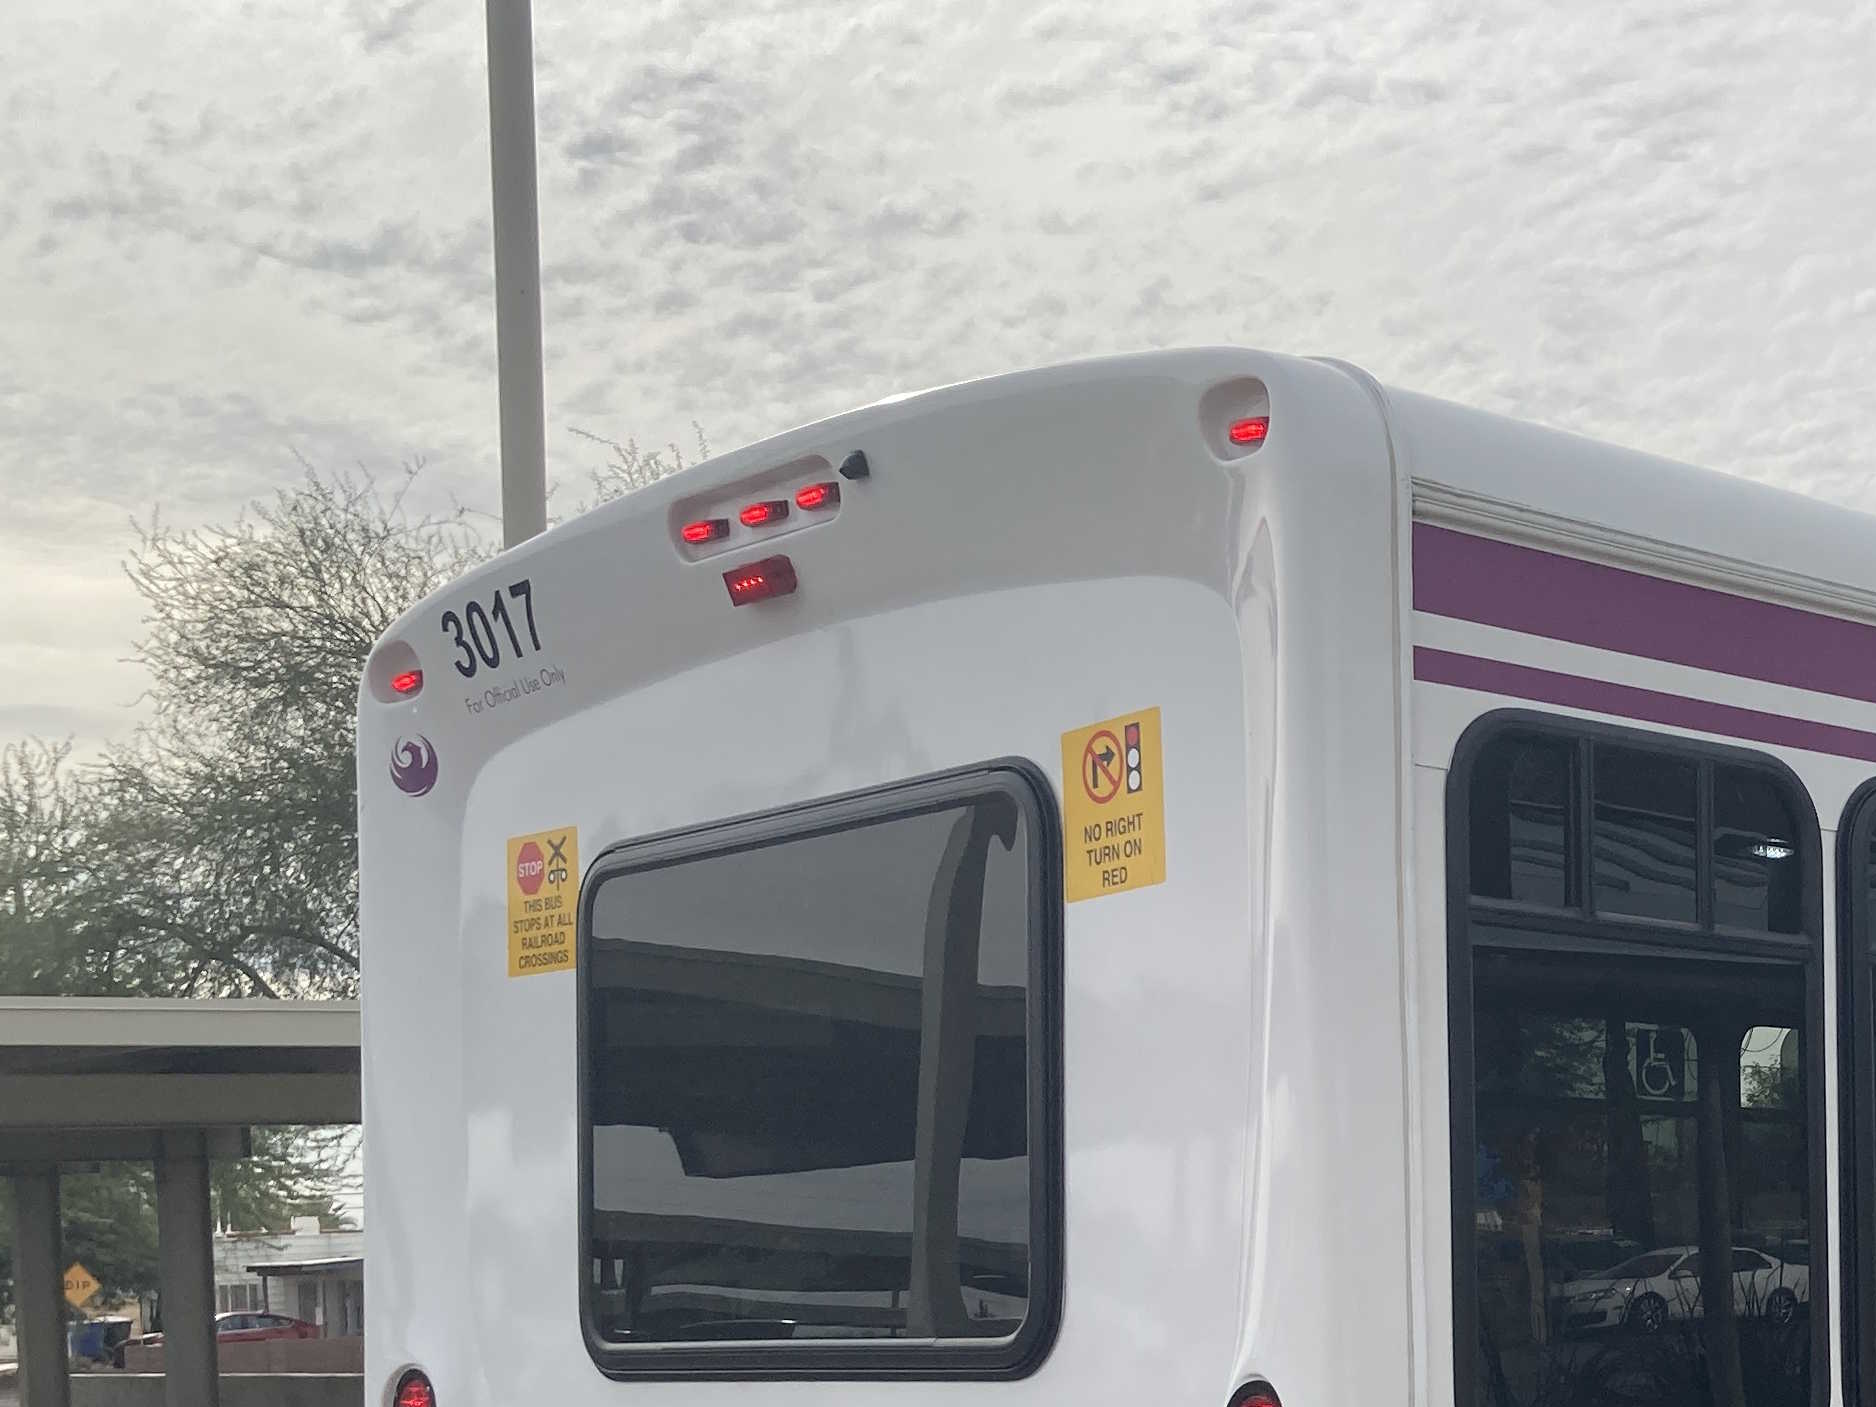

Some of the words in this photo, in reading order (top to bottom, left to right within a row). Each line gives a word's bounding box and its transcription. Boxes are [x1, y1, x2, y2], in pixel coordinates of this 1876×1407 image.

[441, 579, 541, 678] 3017
[1084, 823, 1102, 844] NO
[1105, 812, 1143, 838] RIGHT
[1086, 843, 1121, 867] TURN
[1124, 837, 1142, 858] ON
[519, 860, 544, 878] STOP
[1102, 866, 1128, 888] RED
[524, 898, 543, 913] THIS
[544, 895, 563, 911] BUS
[513, 917, 541, 934] STOPS
[543, 914, 556, 928] AT
[556, 911, 574, 926] ALL
[521, 931, 566, 950] RAILROAD
[519, 949, 569, 969] CROSSINGS
